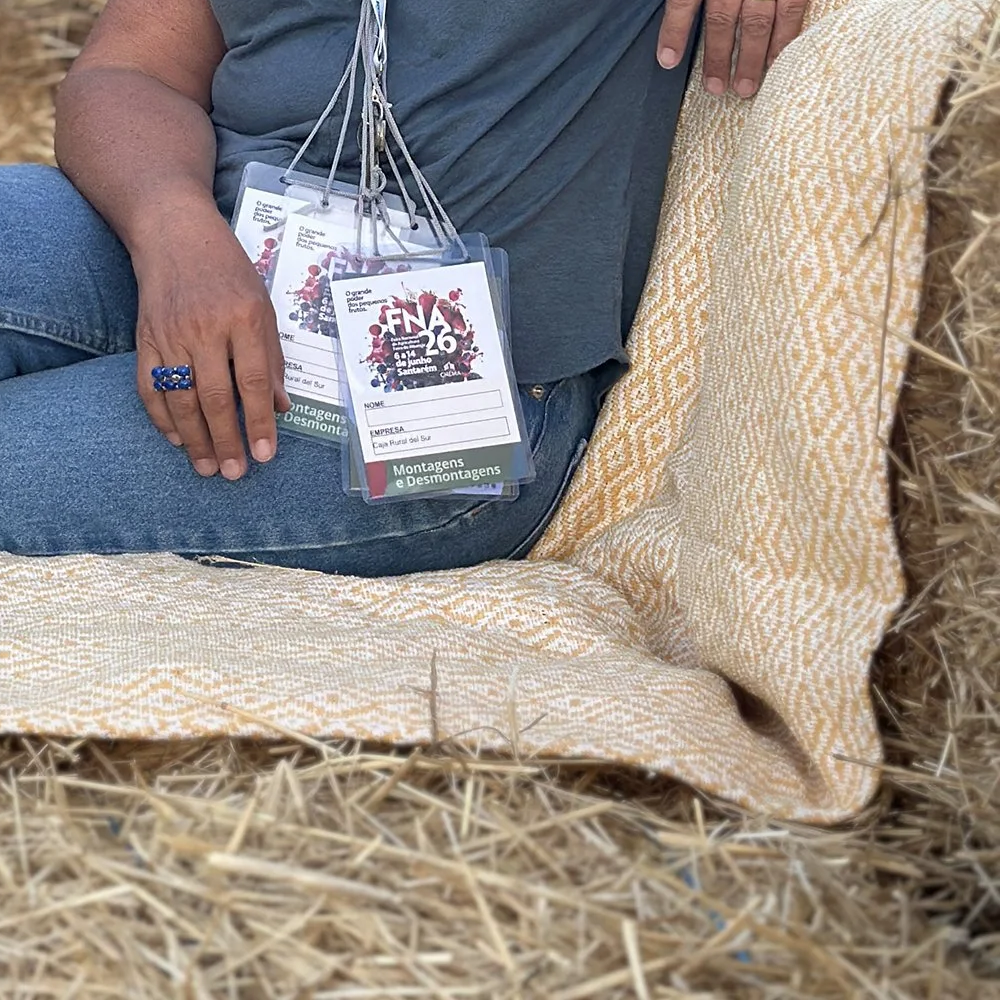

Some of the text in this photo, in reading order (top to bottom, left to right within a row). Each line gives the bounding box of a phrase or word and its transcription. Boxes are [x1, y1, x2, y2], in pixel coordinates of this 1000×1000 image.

[297, 232, 316, 240] poder
[305, 227, 326, 237] grande
[308, 240, 338, 251] pequenos
[351, 288, 372, 297] grande
[359, 298, 388, 308] pequenos
[385, 299, 452, 335] FNA
[280, 332, 296, 341] OME
[417, 328, 458, 356] 26
[394, 351, 400, 359] 6
[406, 350, 416, 359] 14
[395, 356, 432, 368] de junho
[397, 365, 437, 376] Santarém
[313, 381, 325, 389] Sur
[364, 400, 385, 409] NOME
[290, 402, 347, 424] ontagens
[284, 411, 349, 437] Desmonta
[370, 426, 404, 437] EMPRESA
[389, 437, 407, 447] Rural
[408, 435, 420, 444] del
[420, 434, 431, 442] Sur
[393, 458, 465, 477] Montagens
[395, 479, 404, 489] e
[406, 465, 501, 488] Desmontagens
